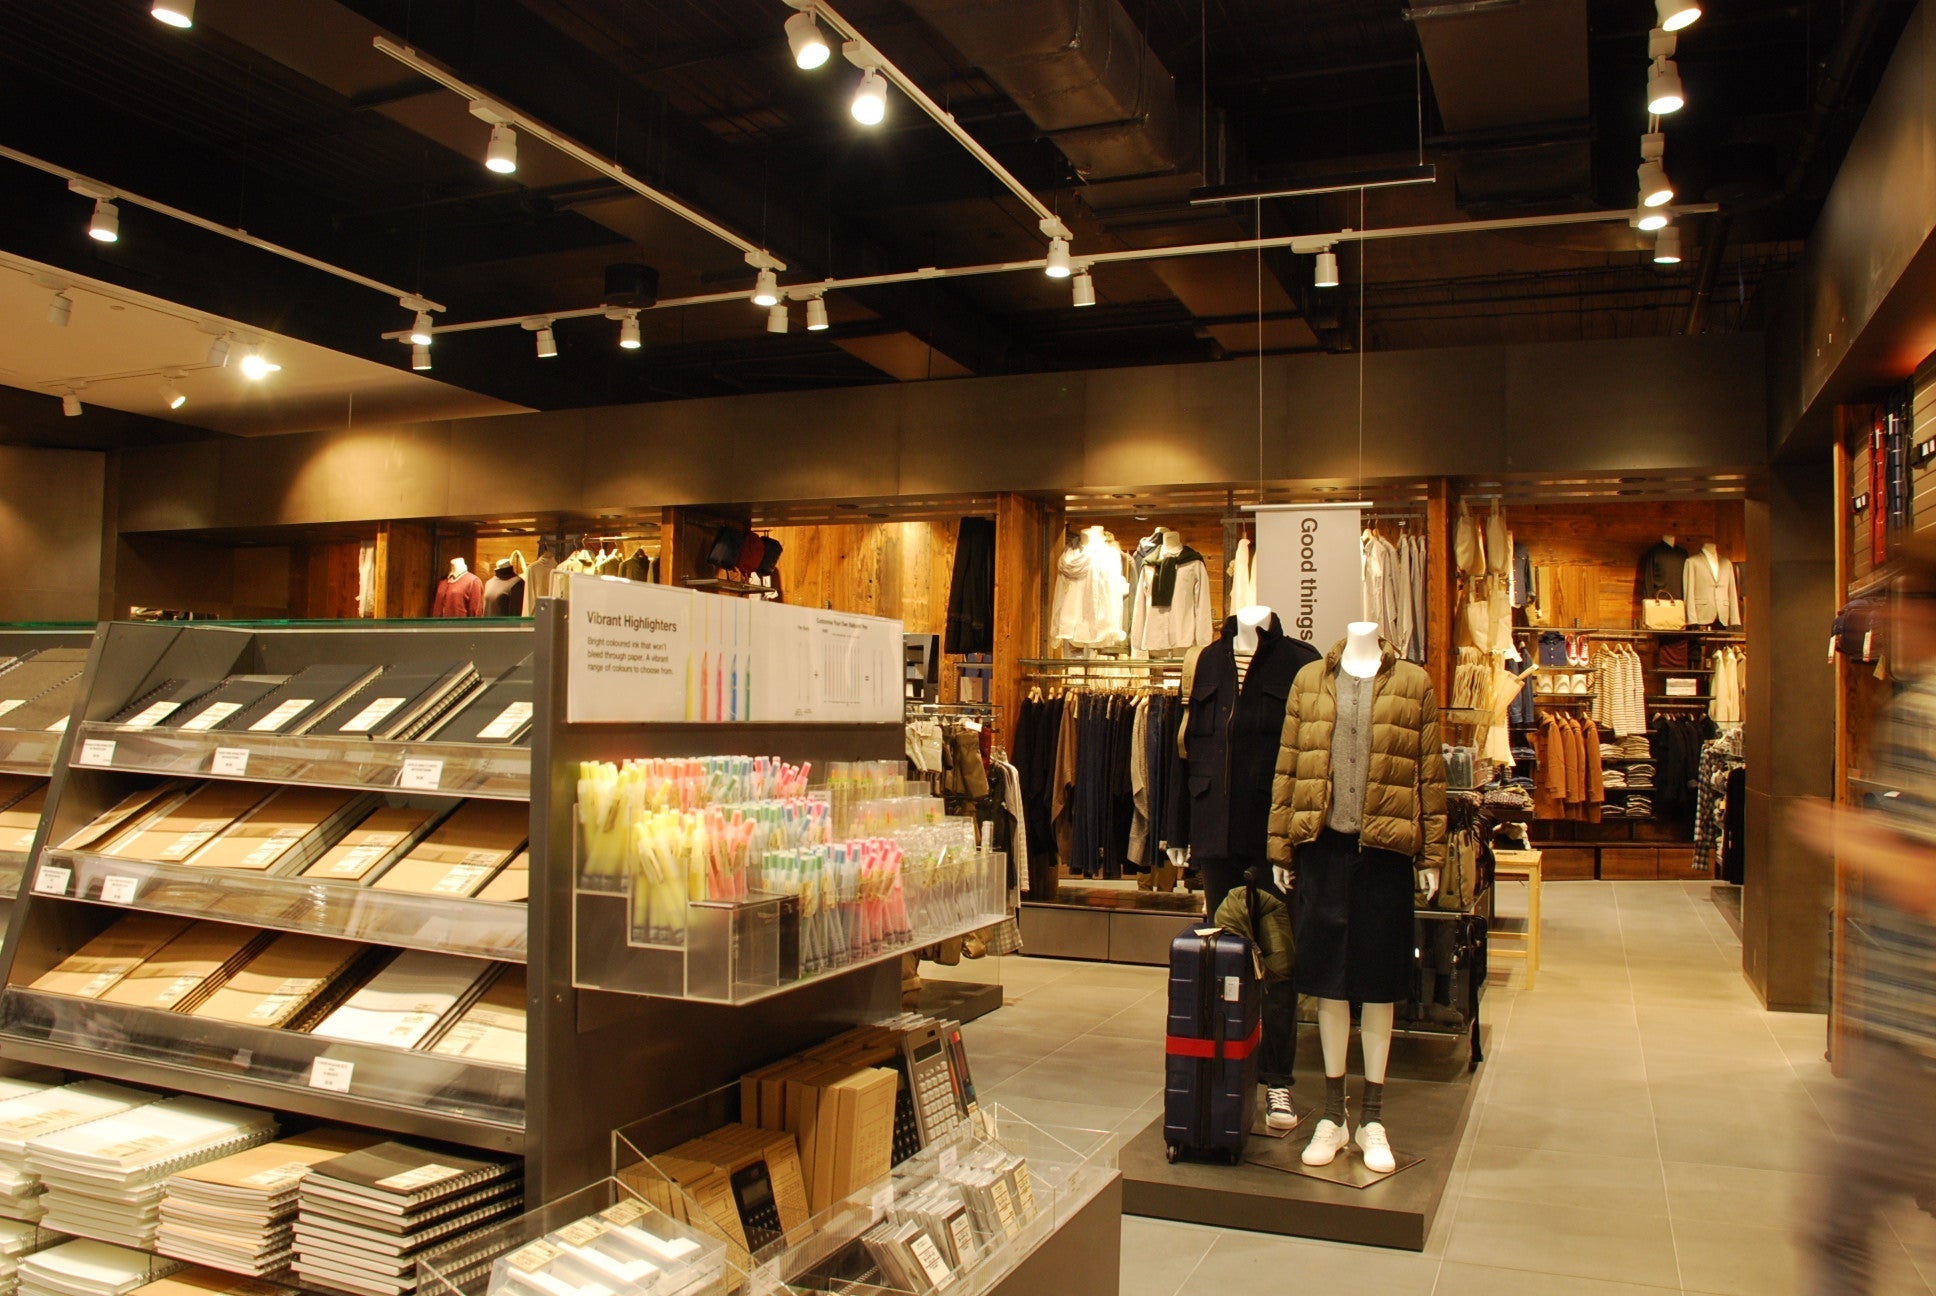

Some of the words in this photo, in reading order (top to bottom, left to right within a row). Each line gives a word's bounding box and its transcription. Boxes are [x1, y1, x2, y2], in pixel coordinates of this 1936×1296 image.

[1301, 517, 1318, 572] Good
[1296, 577, 1317, 641] things
[587, 611, 621, 627] Vibrant
[624, 615, 677, 633] Highlighters
[587, 636, 605, 647] Bright
[606, 638, 631, 648] coloured
[641, 641, 651, 649] that
[587, 650, 603, 658] bleed
[605, 651, 626, 661] through
[652, 654, 669, 663] vibrant
[587, 664, 603, 673] range
[604, 663, 611, 671] of
[612, 664, 633, 673] colours
[640, 666, 659, 674] choose
